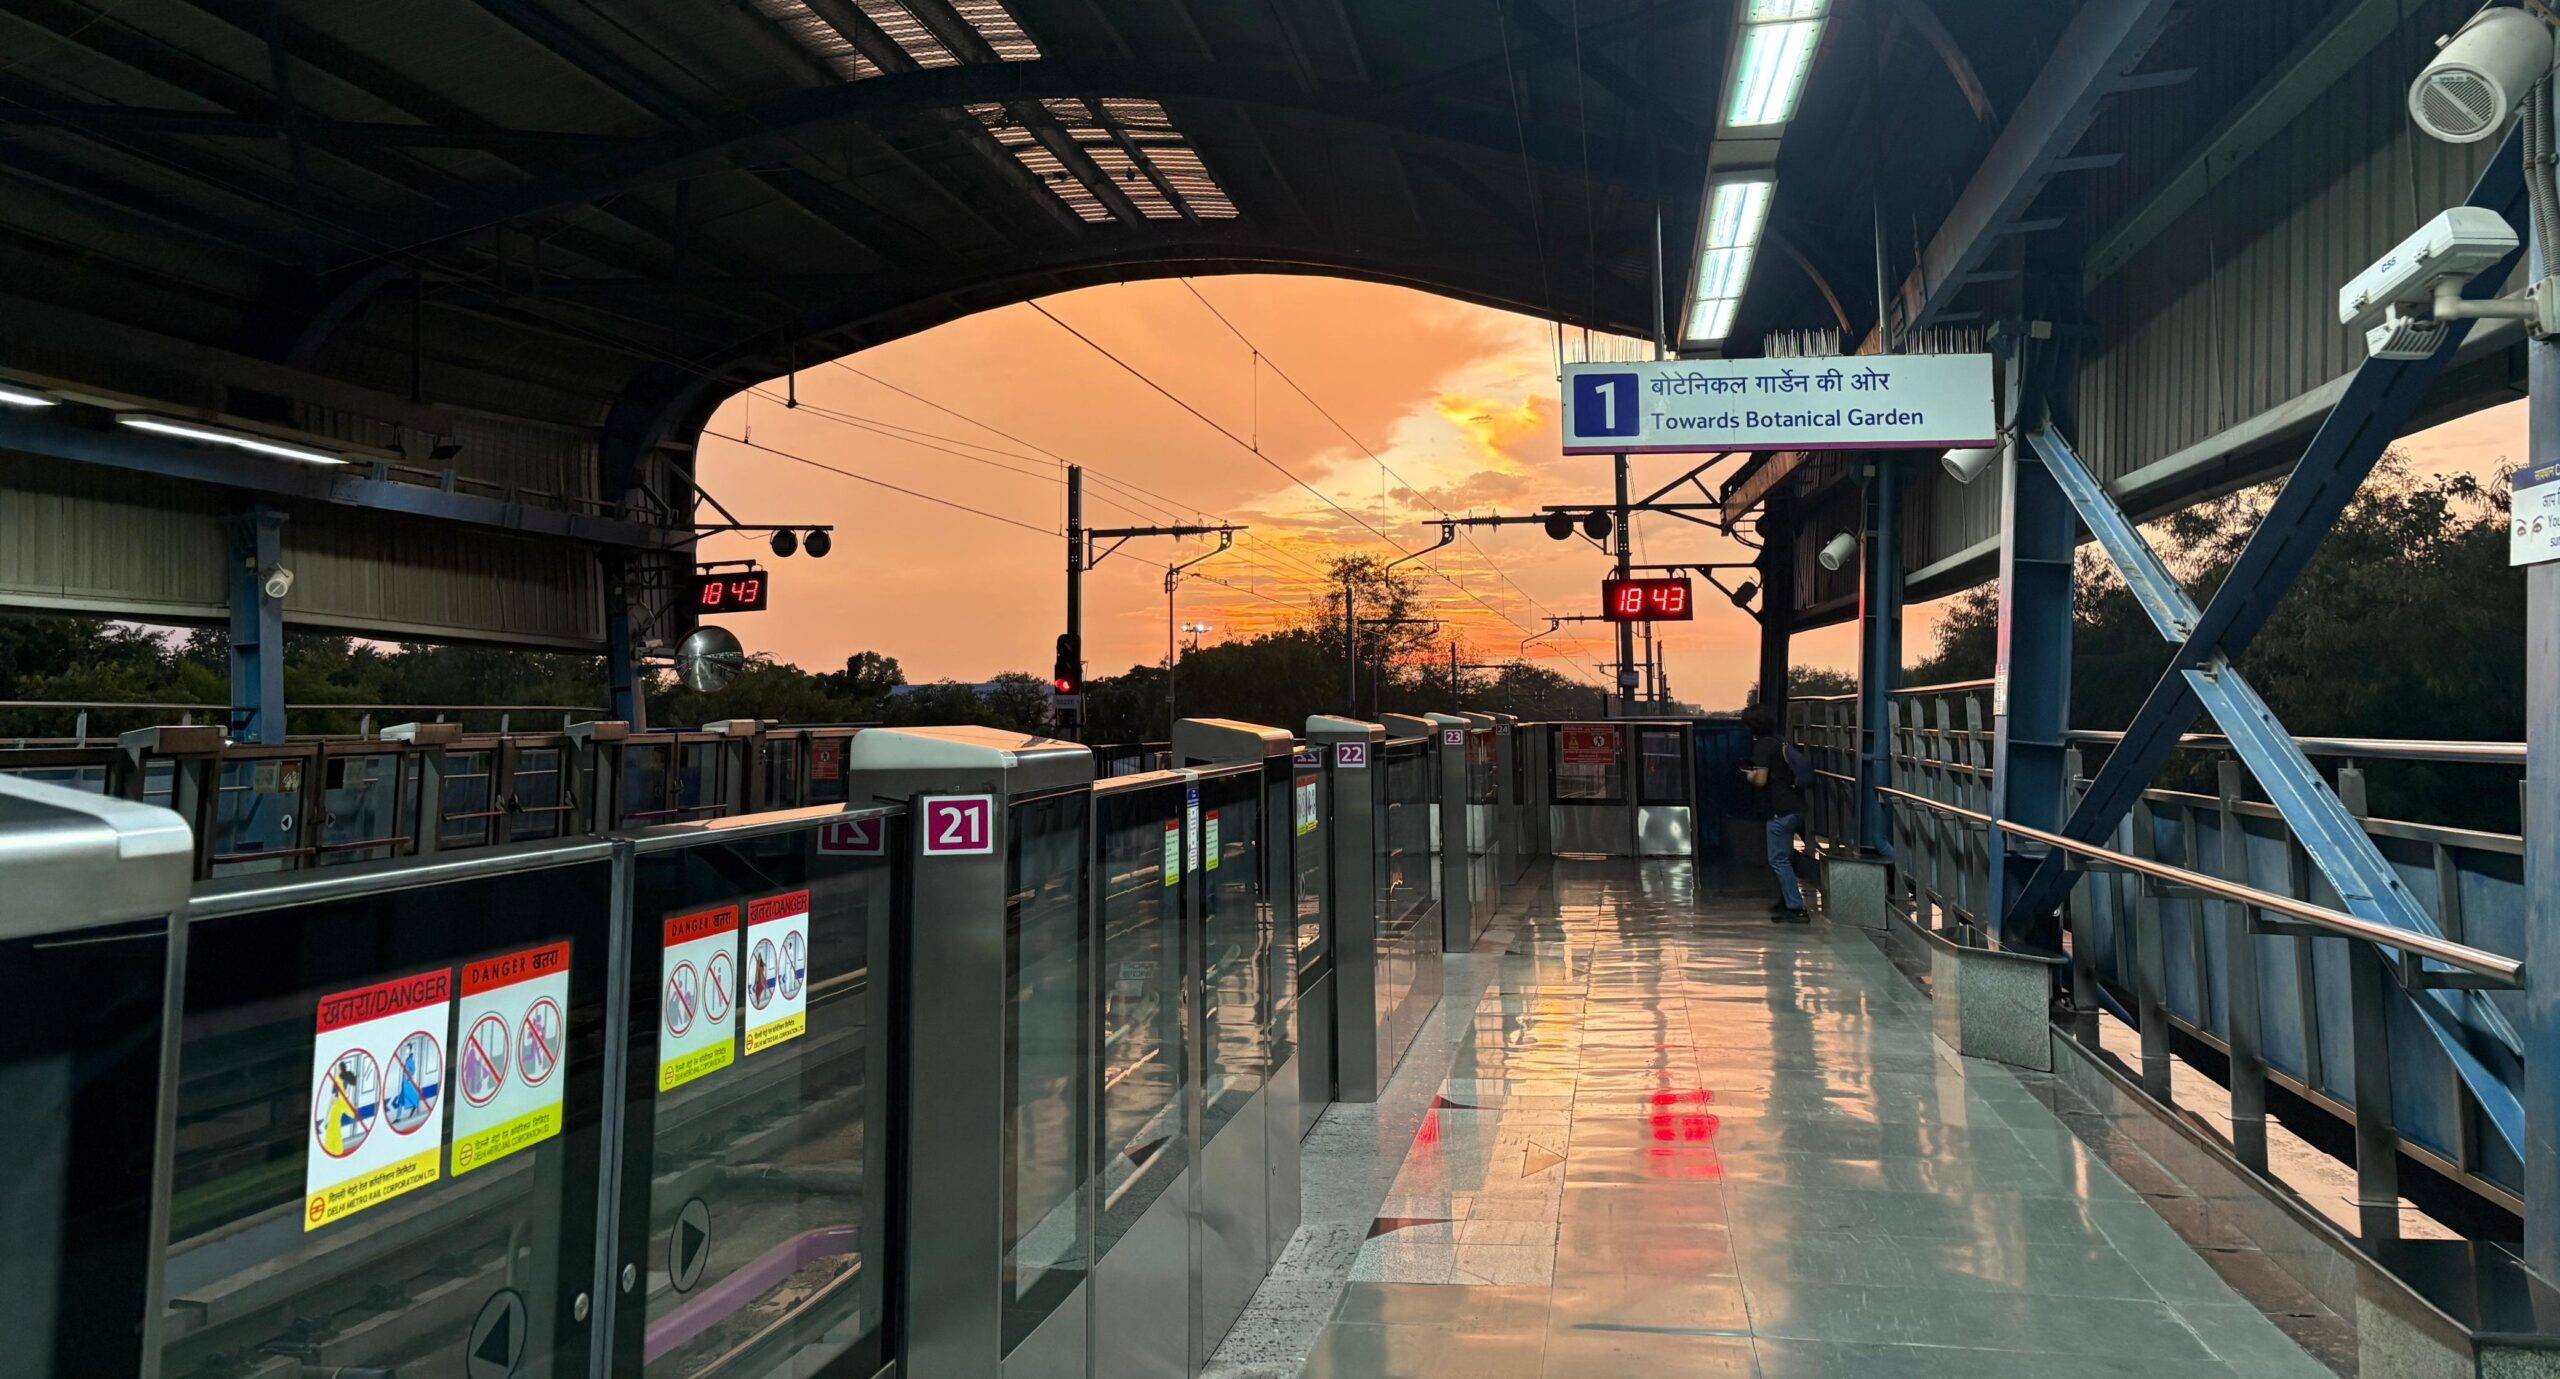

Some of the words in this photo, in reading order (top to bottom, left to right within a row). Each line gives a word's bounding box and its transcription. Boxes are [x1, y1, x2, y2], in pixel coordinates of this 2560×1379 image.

[1651, 371, 1748, 396] बोटेनिकल
[1755, 368, 1810, 394] गार्डेन
[1816, 368, 1844, 393] की
[1851, 366, 1890, 391] ओर
[1595, 382, 1615, 429] 1
[1651, 411, 1740, 430] Towards
[1746, 409, 1841, 428] Botanical
[1848, 408, 1924, 427] Garden
[702, 583, 722, 604] 18
[731, 580, 759, 602] 43
[1620, 588, 1642, 612] 18
[1653, 586, 1684, 611] 43
[1447, 731, 1461, 742] 23
[1341, 746, 1363, 762] 22
[939, 806, 980, 844] 21
[671, 916, 709, 937] DANGER
[472, 957, 526, 984] DANGER
[532, 949, 560, 970] खतरा
[327, 1203, 345, 1218] DELHI
[346, 1194, 368, 1211] METRO
[368, 1188, 382, 1201] RAIL
[383, 1173, 423, 1197] CORPORATION
